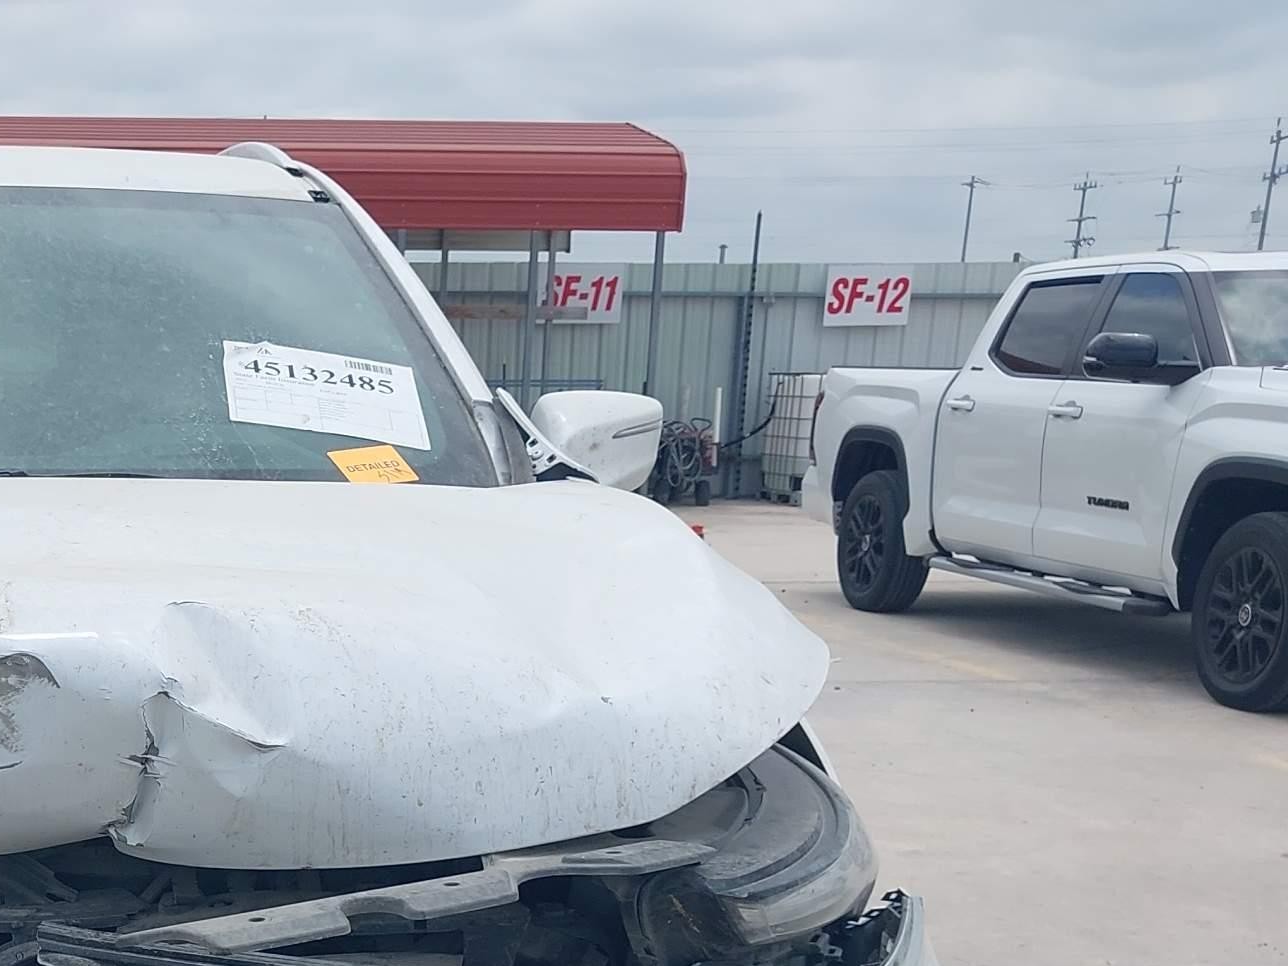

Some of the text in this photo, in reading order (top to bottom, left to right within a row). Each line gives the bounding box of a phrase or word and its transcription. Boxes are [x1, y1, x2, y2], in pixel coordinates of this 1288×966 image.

[827, 277, 910, 315] SF-12
[244, 359, 395, 395] 45132485
[345, 460, 400, 473] DETAILED
